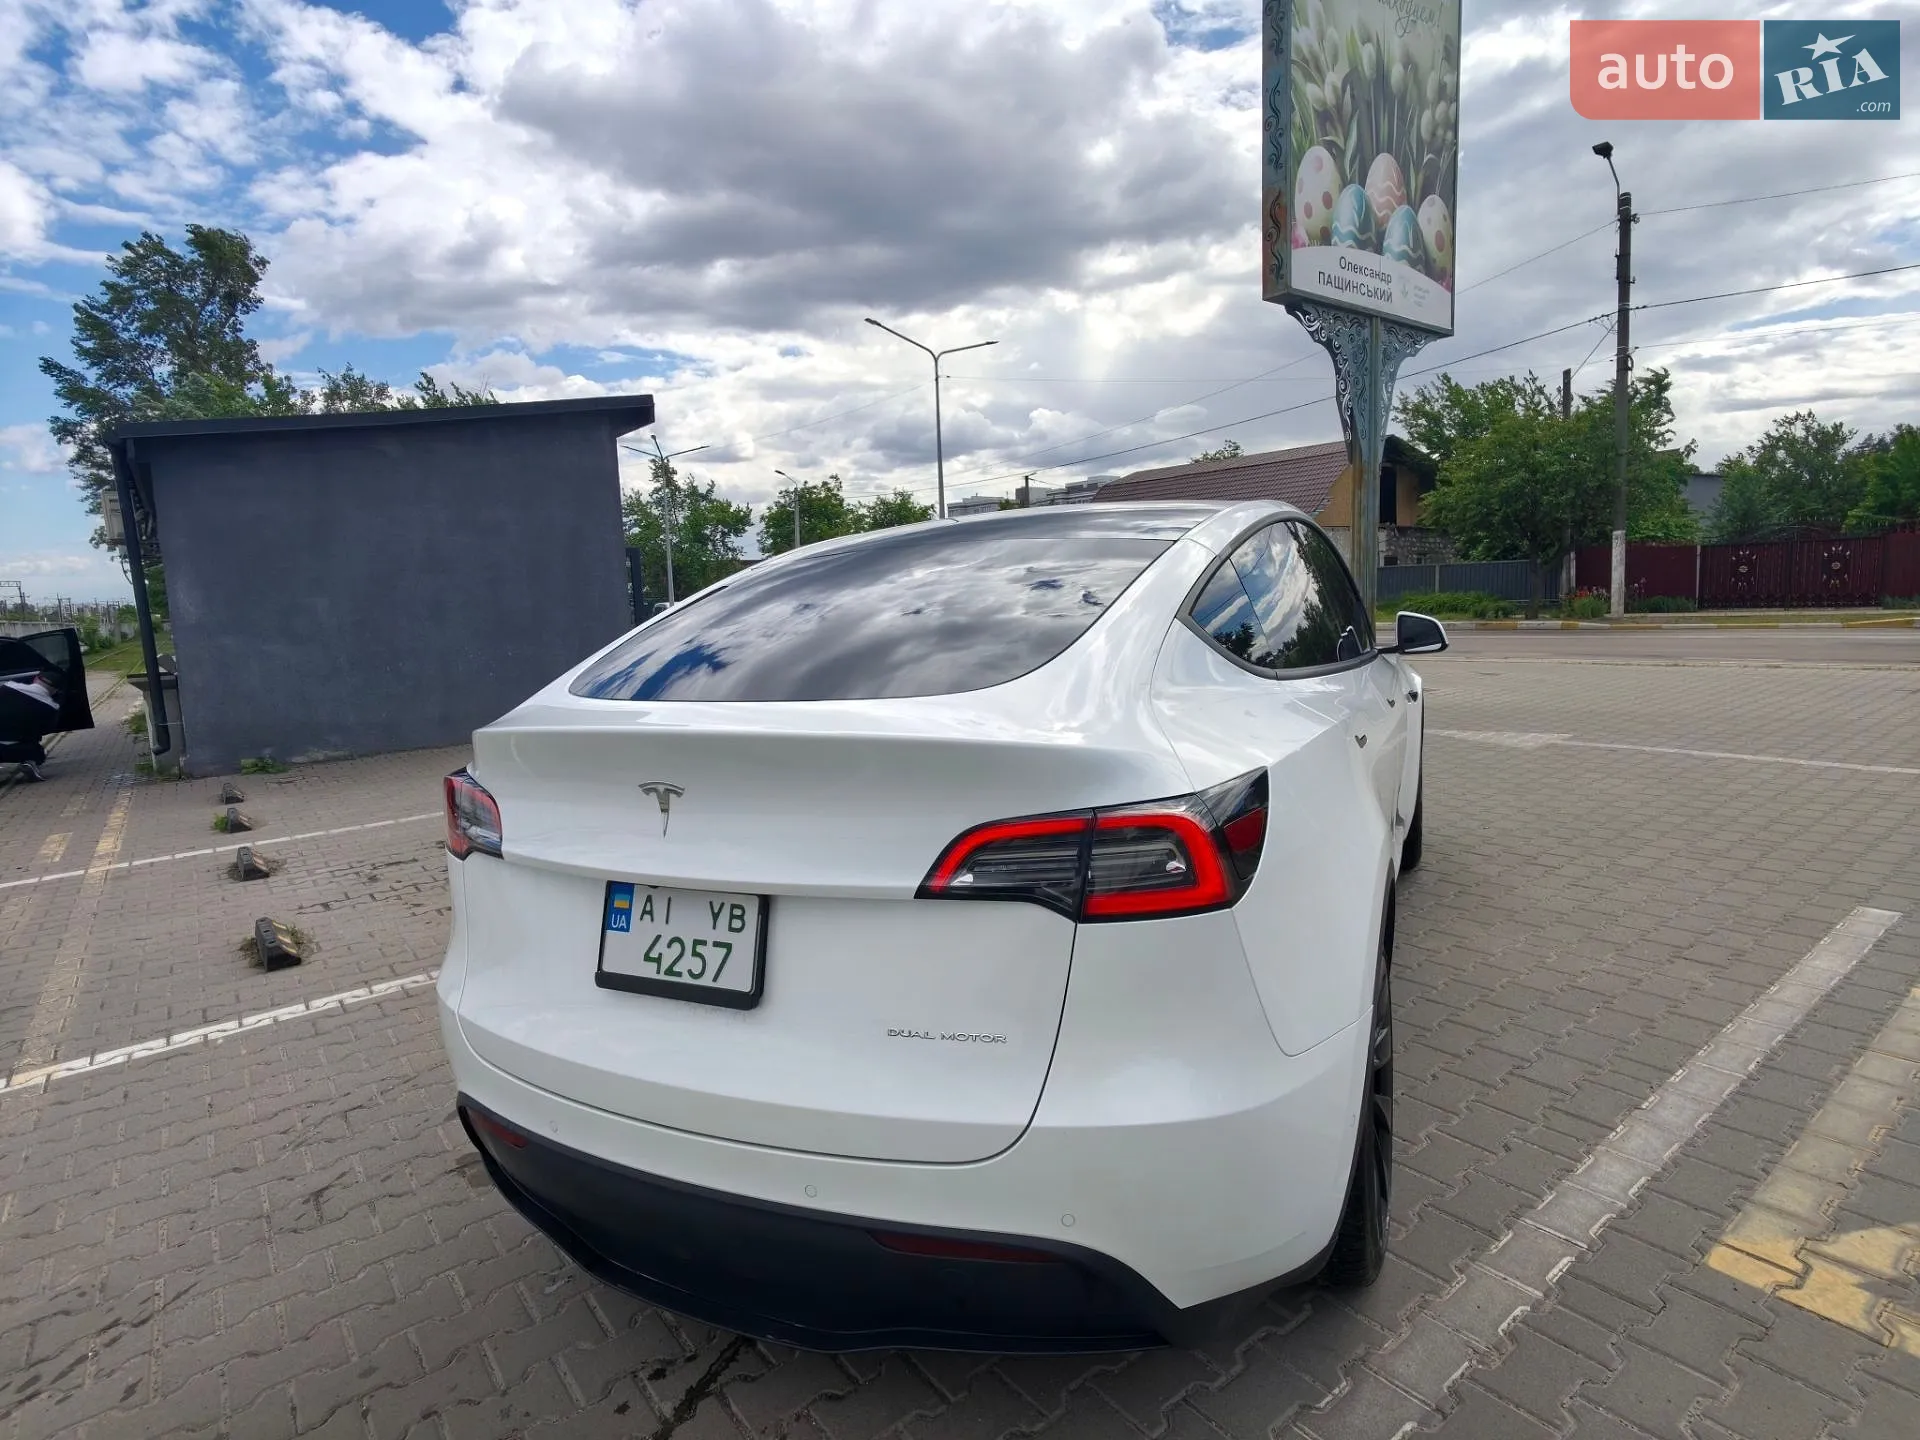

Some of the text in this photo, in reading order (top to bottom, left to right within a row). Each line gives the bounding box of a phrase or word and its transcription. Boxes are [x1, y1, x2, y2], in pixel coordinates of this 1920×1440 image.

[1339, 255, 1392, 286] Олександр
[1318, 270, 1393, 304] ПАЩИНСЬКИЙ
[611, 914, 627, 929] UA
[709, 900, 746, 933] YB
[643, 934, 733, 983] 4257
[887, 1029, 1008, 1044] DUAL MOTOR
